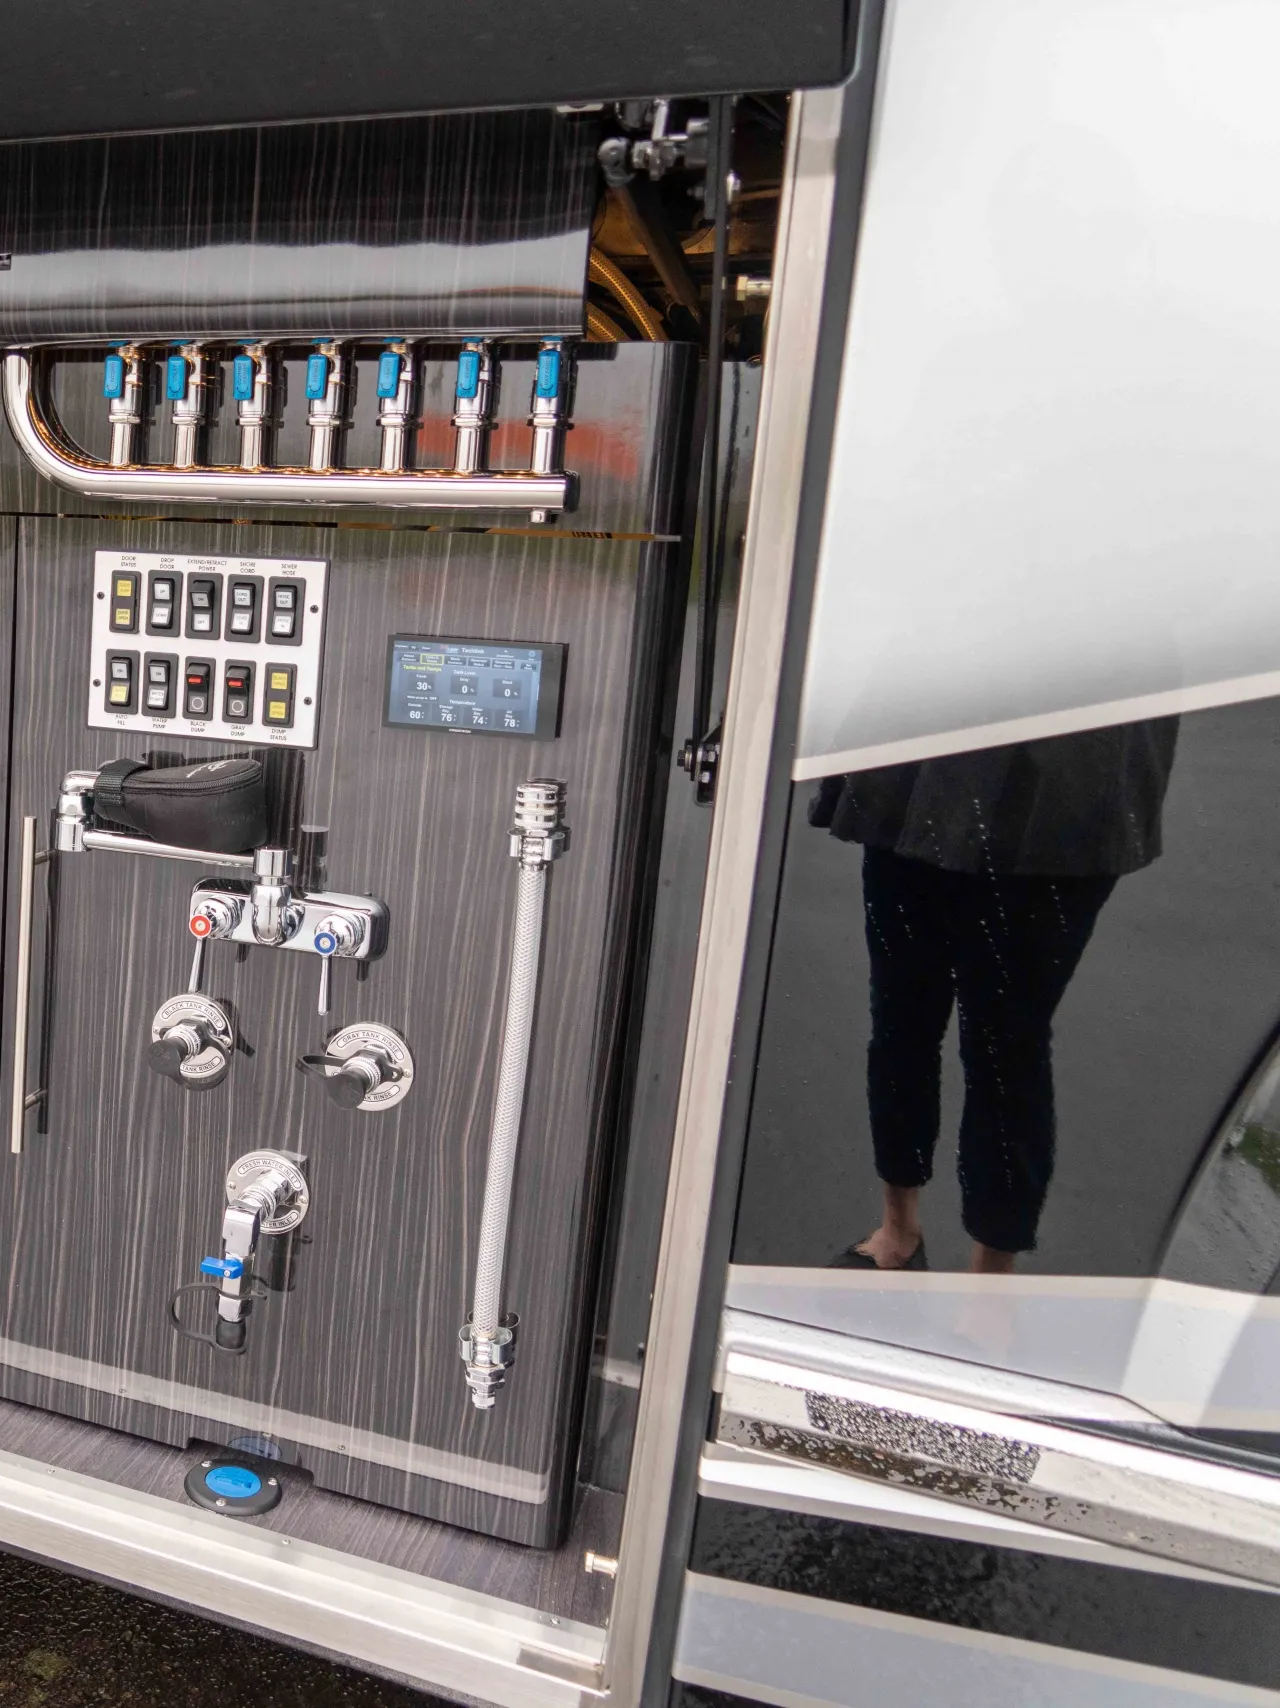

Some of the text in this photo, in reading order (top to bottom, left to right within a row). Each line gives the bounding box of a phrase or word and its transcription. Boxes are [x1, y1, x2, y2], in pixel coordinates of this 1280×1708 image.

[417, 682, 427, 690] 30
[505, 689, 510, 697] 0
[410, 711, 420, 719] 60
[473, 716, 484, 724] 74
[504, 719, 515, 727] 78
[165, 1002, 221, 1026] BLACK TANK RINSE
[342, 1032, 360, 1043] GRAY
[382, 1037, 399, 1053] RINSE
[199, 1061, 216, 1072] RINSE
[373, 1091, 392, 1101] RINSE
[242, 1161, 261, 1171] FRESH
[284, 1168, 298, 1184] INLET
[278, 1216, 293, 1227] INLET
